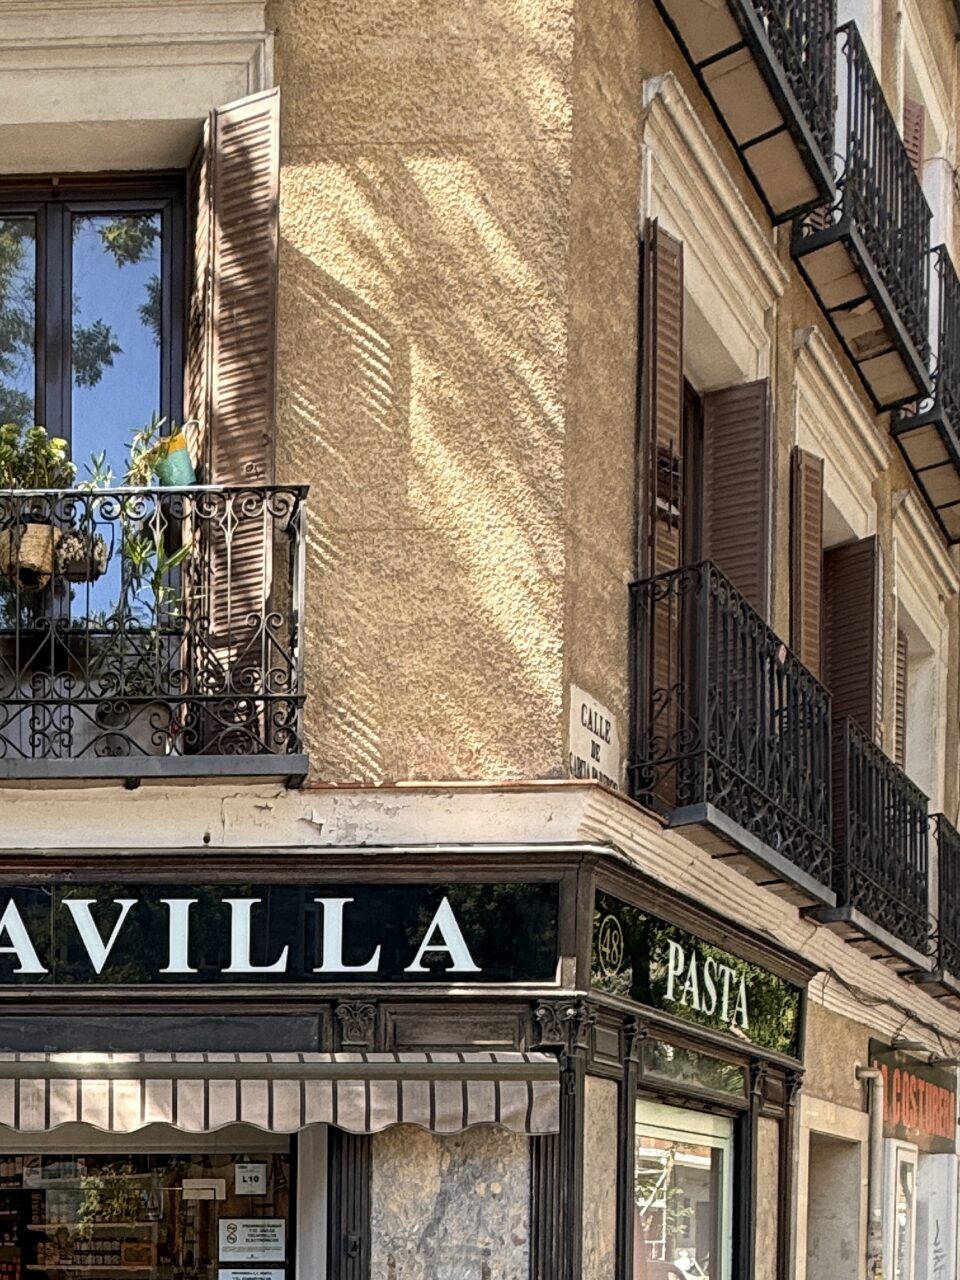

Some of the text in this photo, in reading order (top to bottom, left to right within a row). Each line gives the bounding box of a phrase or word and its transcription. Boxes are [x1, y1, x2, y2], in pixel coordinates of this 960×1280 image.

[581, 703, 611, 745] CALLE
[591, 740, 601, 763] DE
[601, 928, 620, 965] 48
[663, 938, 750, 1030] PASTA
[892, 1067, 955, 1141] COSTURERA
[242, 1175, 260, 1183] L10
